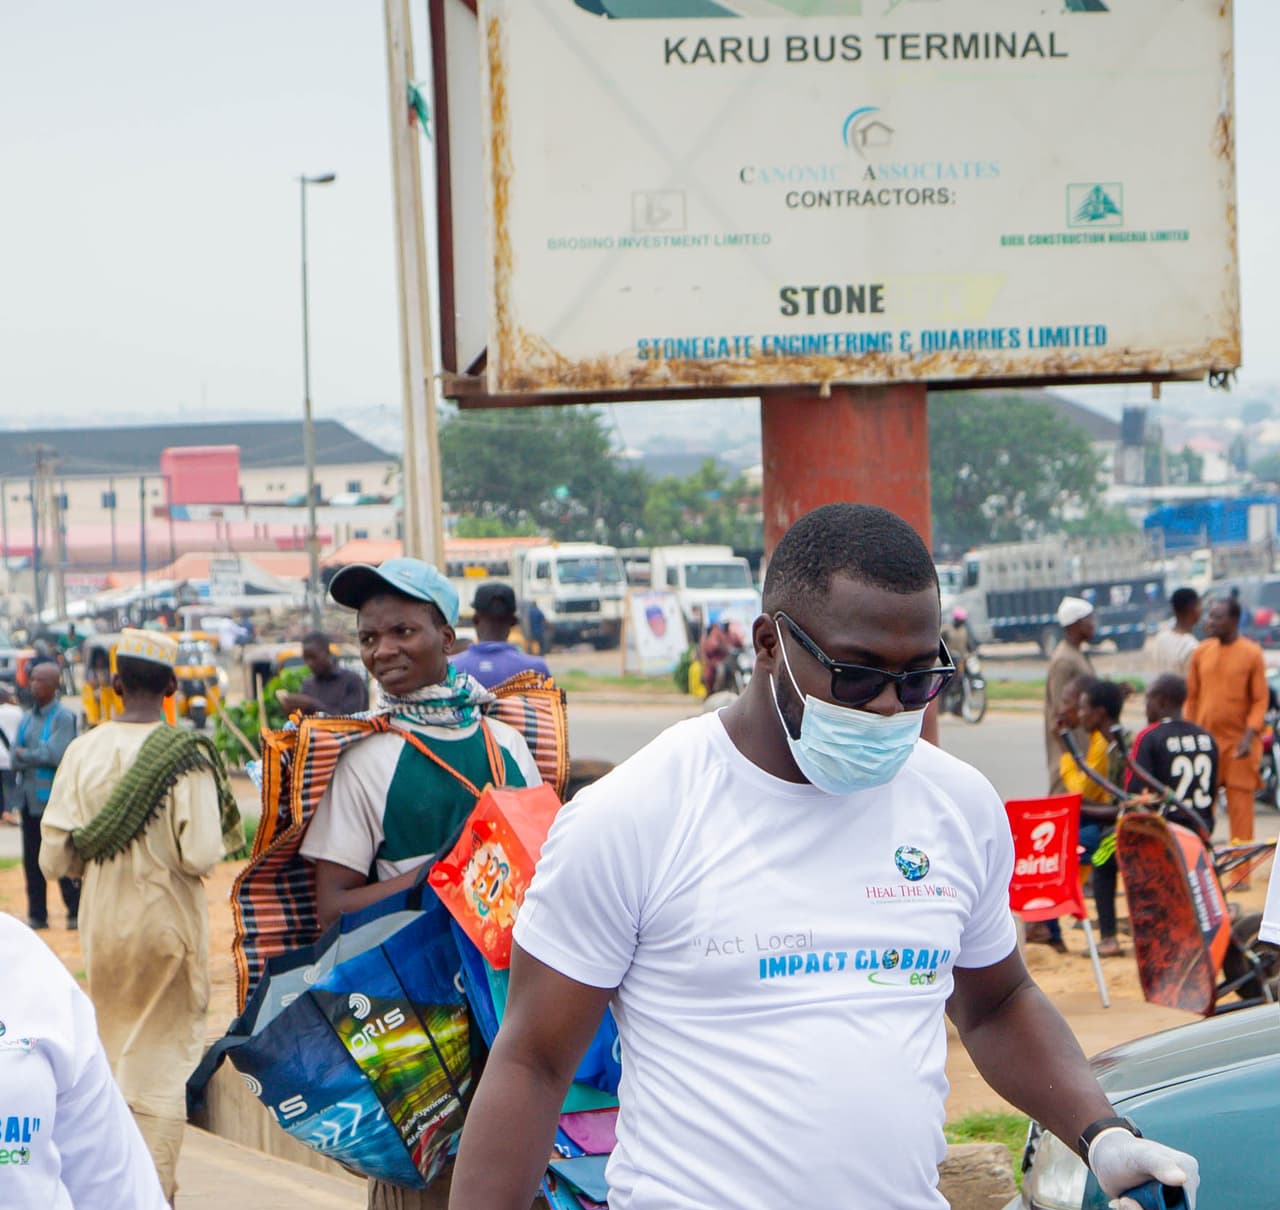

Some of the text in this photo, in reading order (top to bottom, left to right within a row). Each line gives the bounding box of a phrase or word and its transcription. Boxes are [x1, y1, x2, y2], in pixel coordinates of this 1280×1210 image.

[663, 32, 1069, 65] KARU BUS TERMINAL
[863, 160, 1001, 182] ASSOCIATES
[785, 187, 957, 209] CONTRACTORS:
[617, 234, 710, 249] INVESTMENT
[714, 232, 772, 247] LIMITED
[779, 283, 886, 317] STONE
[636, 334, 754, 361] STONEGATE
[760, 331, 893, 357] ENGINEERING
[920, 327, 1021, 354] QUARRIES
[1028, 324, 1108, 349] LIMITED
[1170, 753, 1213, 809] 23
[1015, 853, 1060, 876] airtel
[865, 886, 896, 899] HEAL
[898, 885, 922, 897] THE
[754, 929, 814, 952] Local
[759, 952, 848, 980] IMPACT
